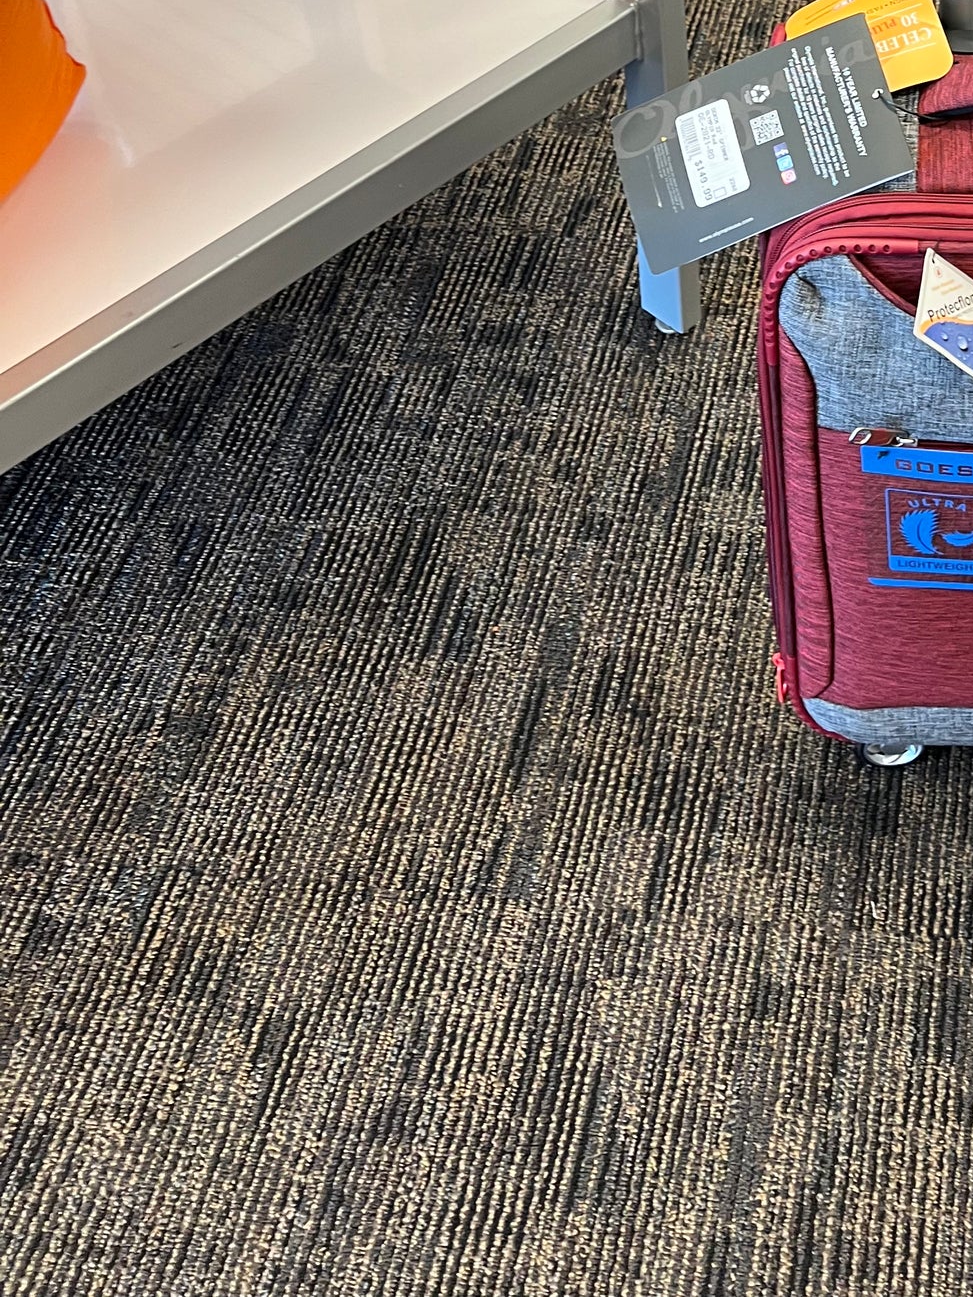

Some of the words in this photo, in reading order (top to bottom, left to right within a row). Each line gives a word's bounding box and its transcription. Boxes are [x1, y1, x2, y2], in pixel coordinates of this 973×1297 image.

[899, 11, 919, 28] 30
[841, 66, 850, 76] 10
[844, 75, 857, 97] YEAR
[825, 46, 853, 113] MANUFACTURER'S
[846, 113, 867, 156] WARRANTY
[850, 96, 867, 127] LIMITED
[694, 159, 713, 201] $149.99
[895, 459, 973, 477] GOES
[908, 498, 967, 512] ULTRA
